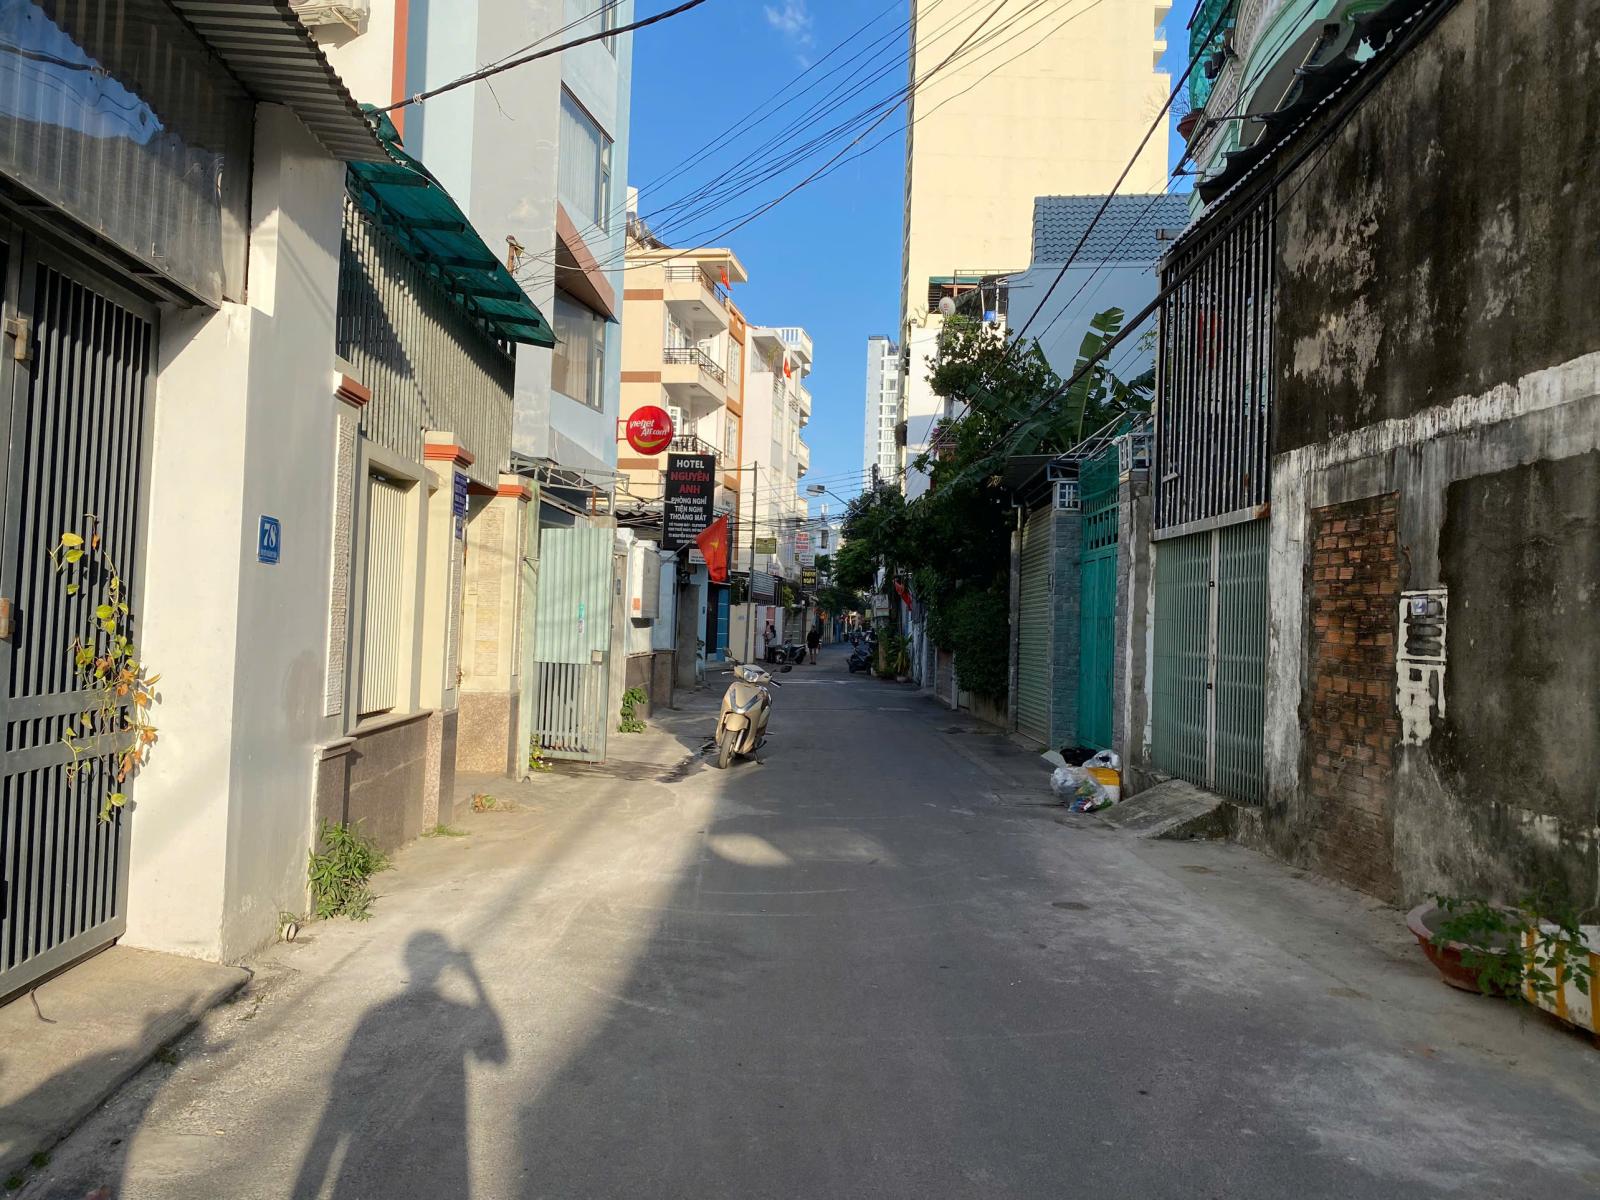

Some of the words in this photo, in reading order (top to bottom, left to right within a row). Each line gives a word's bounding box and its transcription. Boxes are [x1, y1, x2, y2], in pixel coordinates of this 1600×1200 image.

[676, 460, 705, 469] HOTEL
[669, 512, 694, 521] THOÁNG
[263, 523, 277, 548] 78
